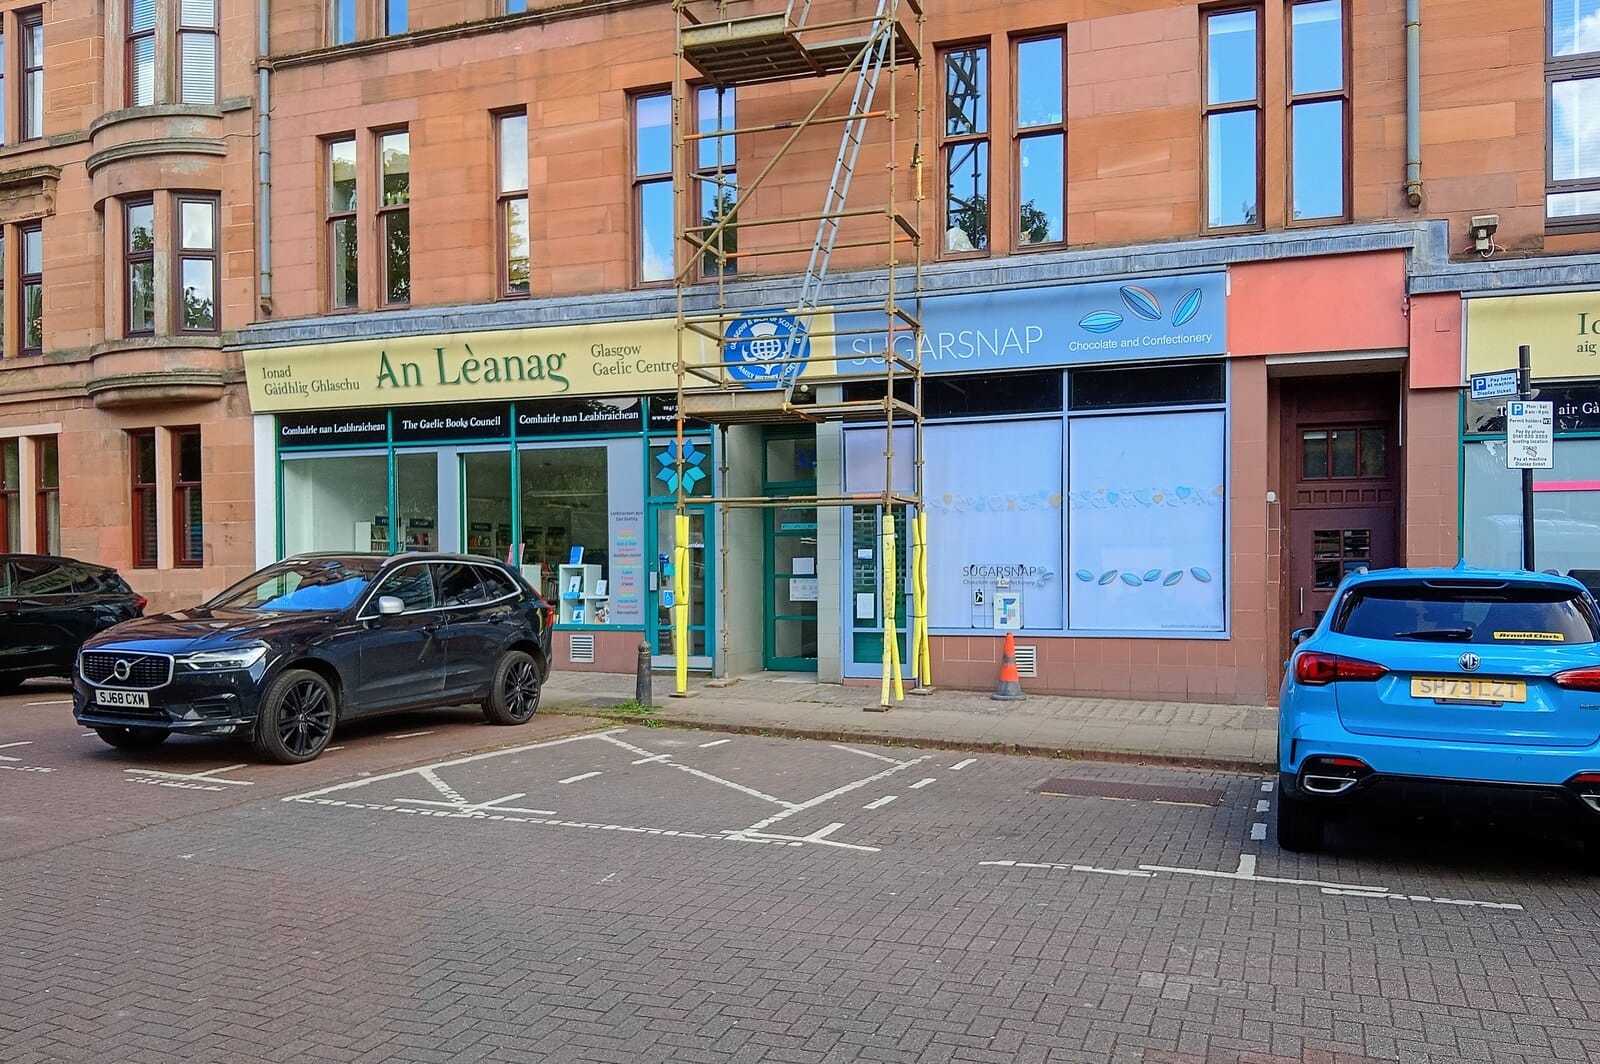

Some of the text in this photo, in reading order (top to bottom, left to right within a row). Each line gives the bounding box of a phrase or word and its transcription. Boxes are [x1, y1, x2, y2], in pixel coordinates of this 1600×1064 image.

[851, 325, 1044, 366] SUGARSNAP
[1068, 333, 1213, 351] Chocolate and Confectionery
[1576, 340, 1597, 357] aig
[590, 343, 642, 361] Glasgow
[262, 364, 292, 379] Ionad
[376, 343, 570, 393] An Lèanag
[592, 359, 679, 376] Gaelic Centre
[264, 377, 360, 397] Gàidhlig Ghlaschu
[1476, 379, 1485, 390] P
[1513, 404, 1522, 415] P
[1558, 403, 1578, 415] air
[1582, 401, 1600, 415] Gà
[402, 415, 501, 430] The Gaelic Books Council
[519, 413, 560, 424] Comhairle
[562, 414, 578, 422] nan
[579, 410, 639, 422] Leabhraichean
[319, 426, 332, 434] nan
[962, 566, 1037, 577] SUGARSNAP
[1459, 652, 1479, 670] MG
[1420, 678, 1518, 698] SH73 LZT
[100, 691, 124, 704] SJ68
